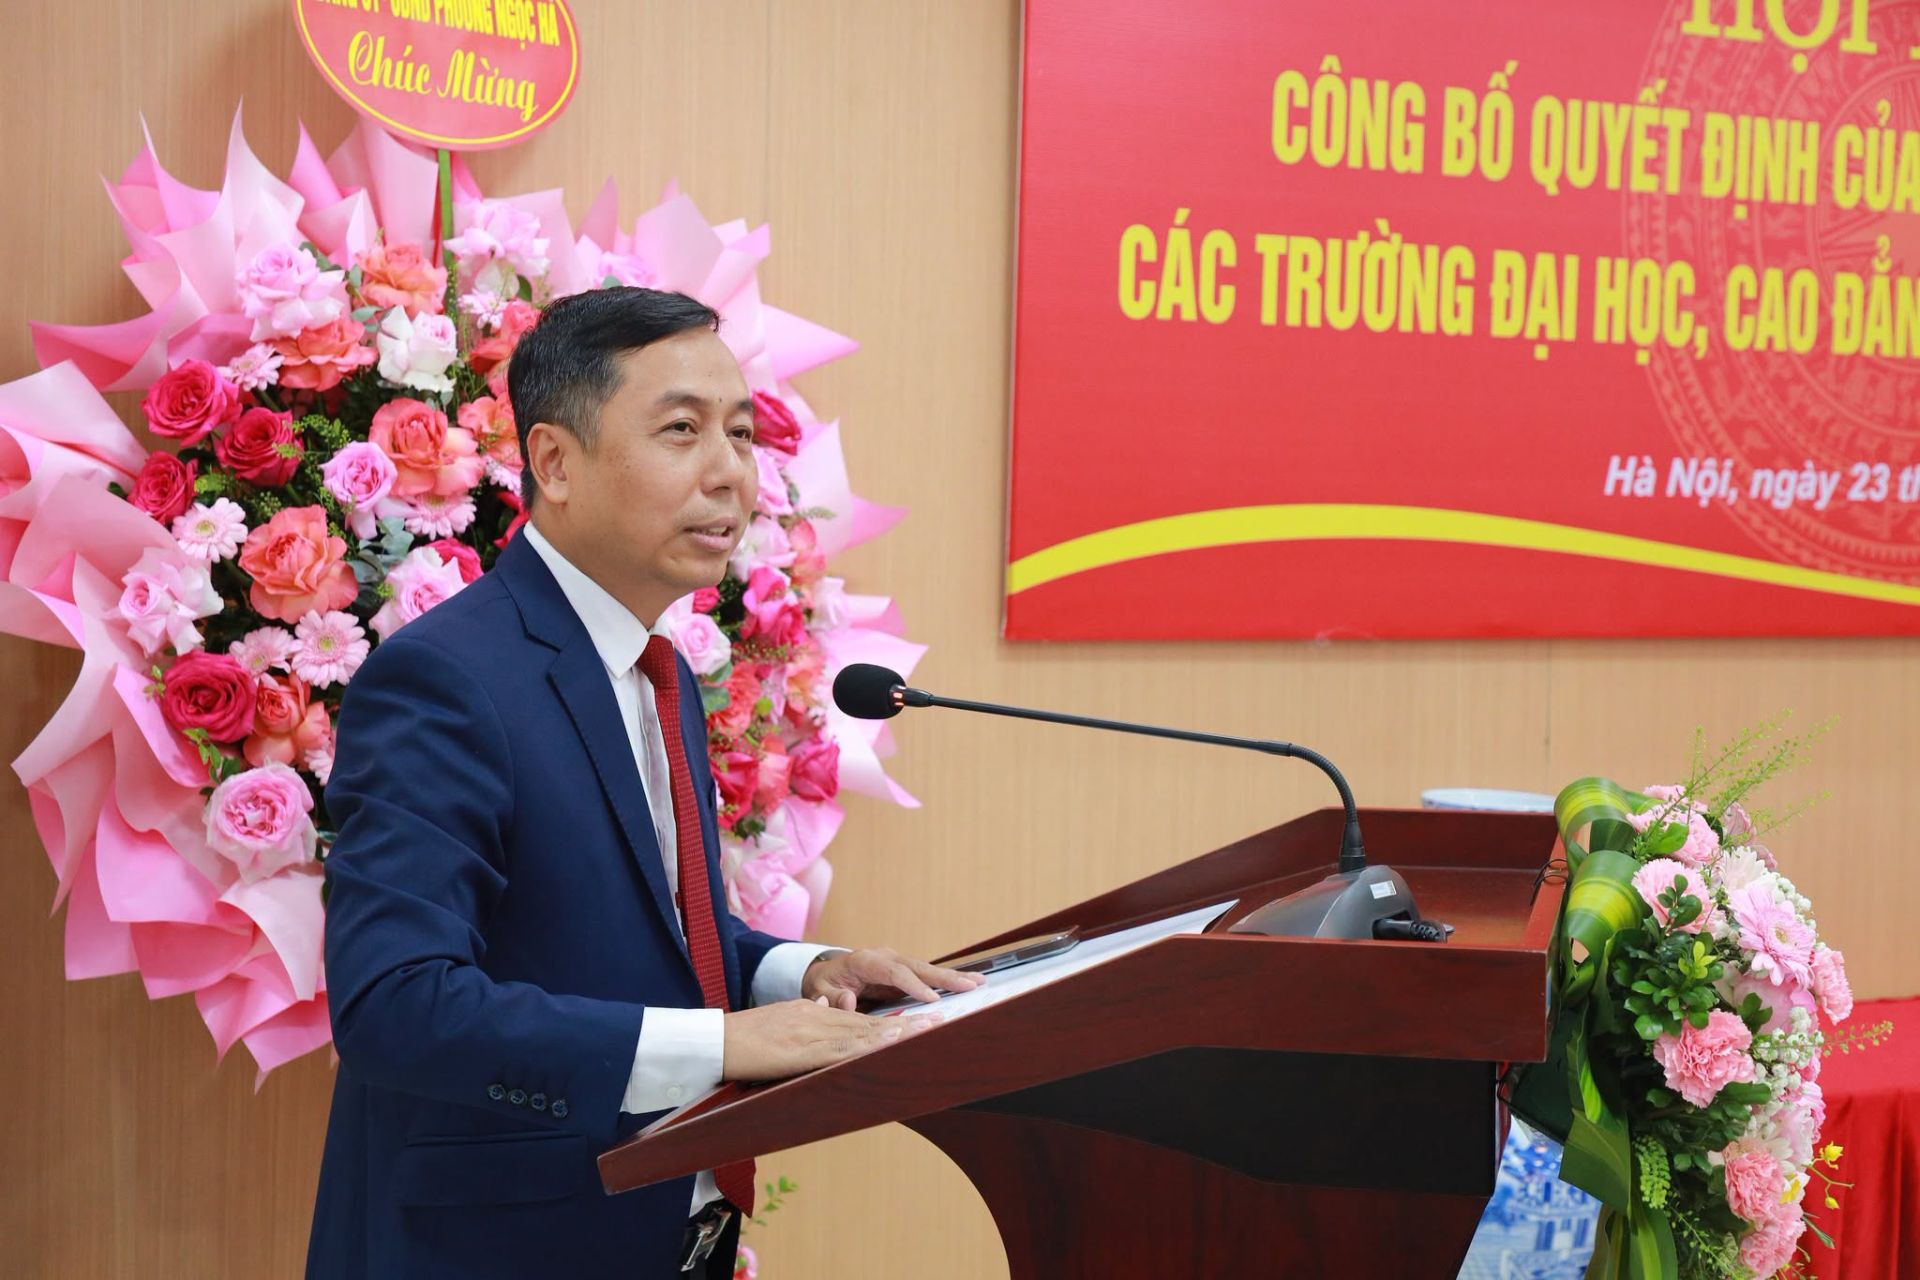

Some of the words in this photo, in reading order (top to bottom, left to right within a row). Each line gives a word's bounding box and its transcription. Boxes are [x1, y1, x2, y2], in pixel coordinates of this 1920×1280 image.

[494, 0, 537, 50] NGỌC
[348, 31, 432, 95] Chúc
[436, 49, 539, 123] Mừng
[1271, 55, 1426, 174] CÔNG
[1441, 60, 1518, 181] BỐ
[1530, 78, 1690, 196] QUYẾT
[1701, 112, 1820, 220] ĐỊNH
[1832, 99, 1920, 215] CỦA
[1118, 207, 1237, 324] CÁC
[1255, 218, 1475, 336] TRƯỜNG
[1490, 249, 1579, 360] ĐẠI
[1593, 256, 1709, 365] HỌC,
[1724, 265, 1819, 354] CAO
[1603, 455, 1657, 497] Hà
[1666, 457, 1739, 508] Nội,
[1750, 460, 1841, 510] ngày
[1848, 462, 1891, 502] 23
